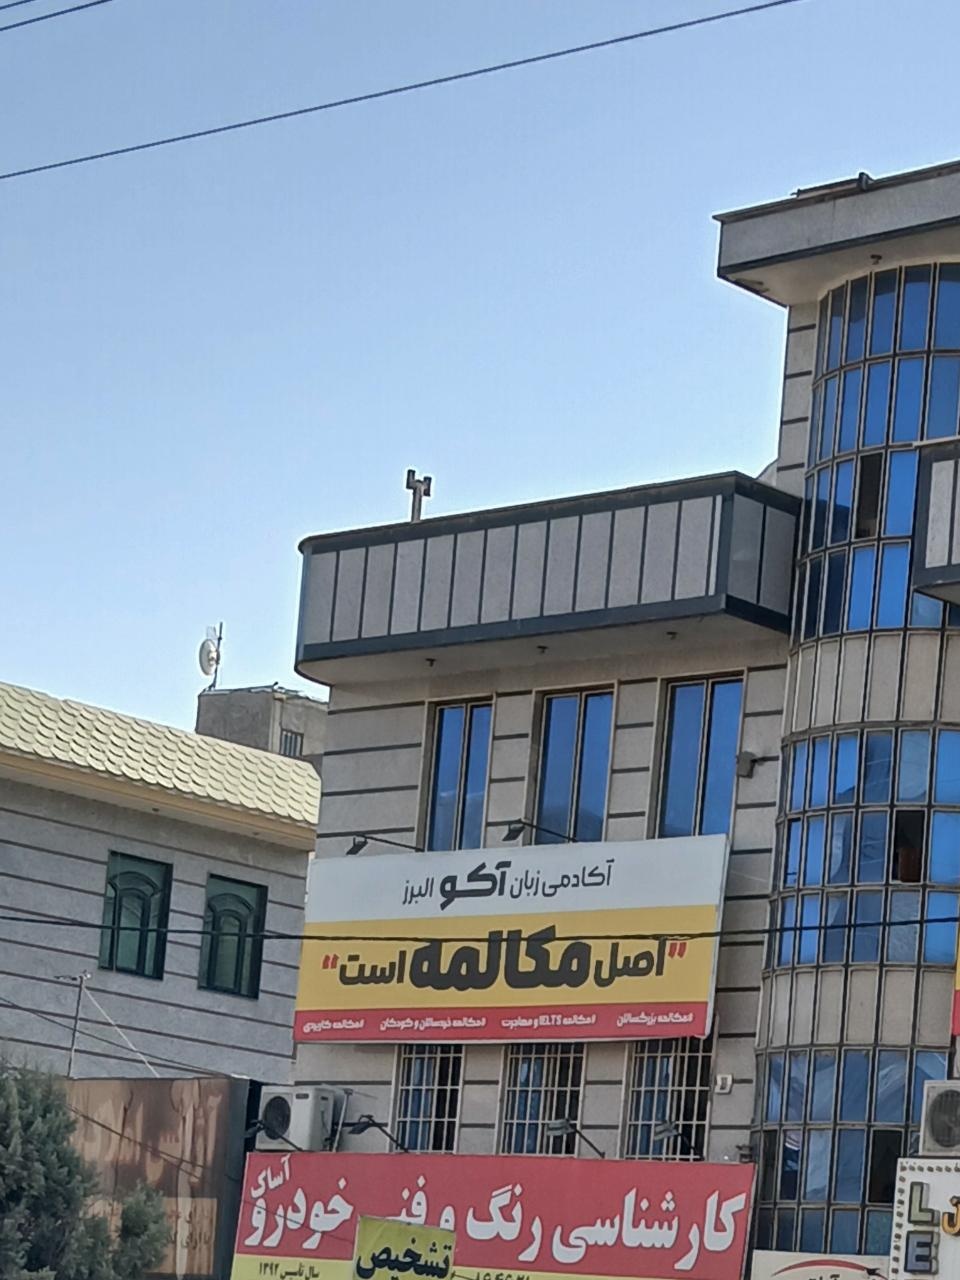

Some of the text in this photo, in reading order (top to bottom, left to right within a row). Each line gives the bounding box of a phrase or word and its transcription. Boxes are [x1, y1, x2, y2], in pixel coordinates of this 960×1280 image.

[402, 859, 615, 910] آکادمی زبان آکو البرز
[409, 925, 591, 991] مکالمه
[539, 1014, 562, 1026] IELTS
[244, 1177, 354, 1249] خودرو
[466, 1183, 542, 1262] رنگ
[356, 1236, 452, 1280] تشخیص
